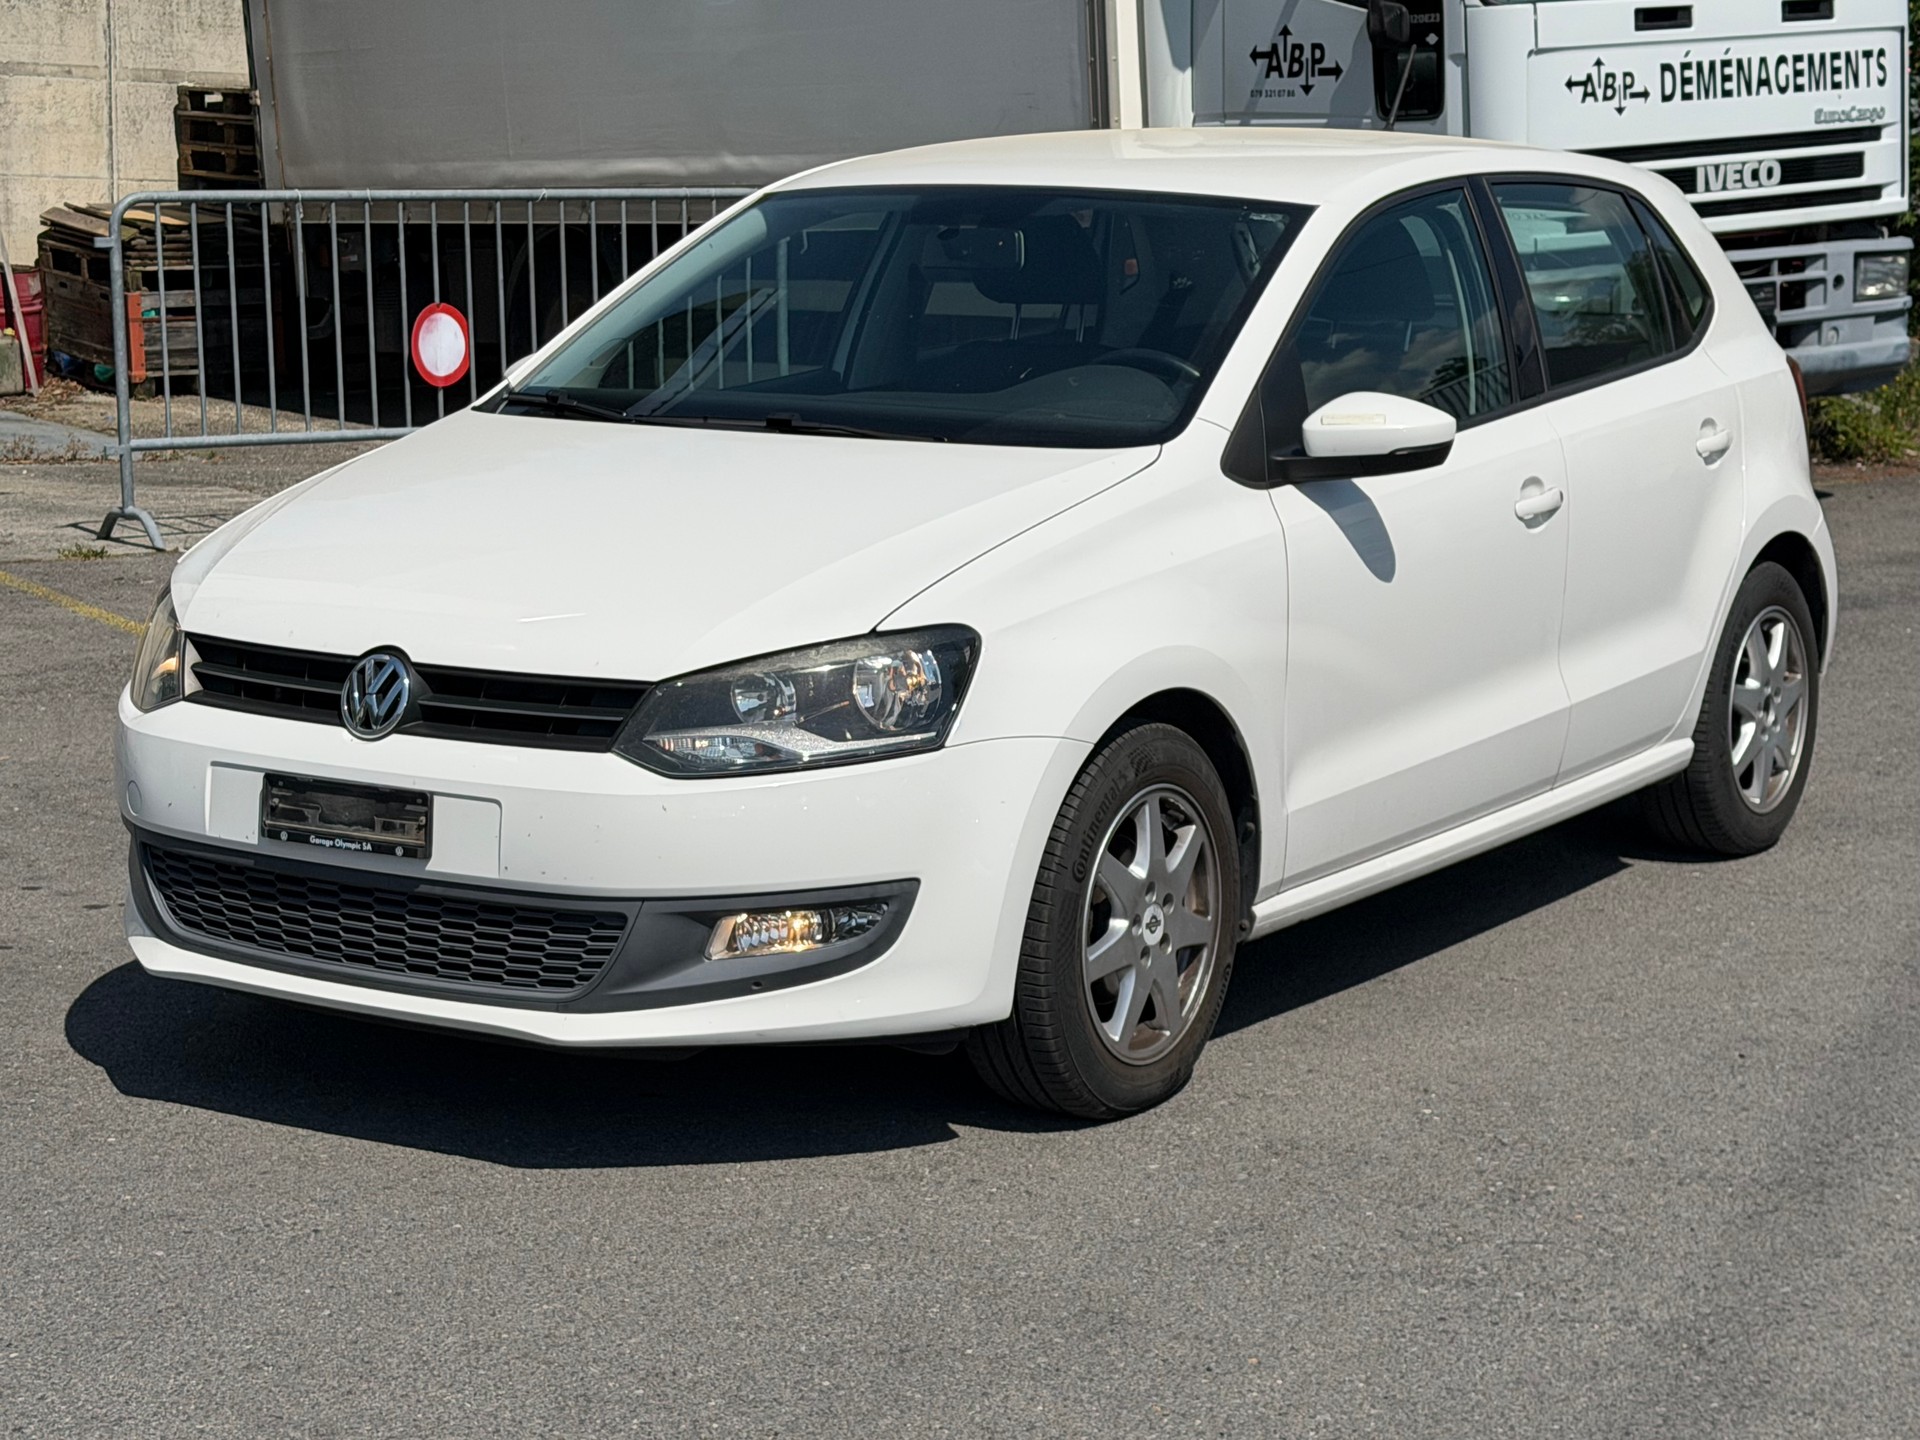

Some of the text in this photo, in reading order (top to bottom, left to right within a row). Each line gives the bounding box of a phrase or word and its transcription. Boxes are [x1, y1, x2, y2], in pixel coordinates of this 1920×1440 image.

[1265, 42, 1326, 78] ABP
[1580, 47, 1888, 104] ABP DÉMÉNAGEMENTS
[1697, 159, 1782, 194] IVECO
[310, 835, 372, 851] Garage Olympic SA
[1072, 778, 1121, 883] Continental
